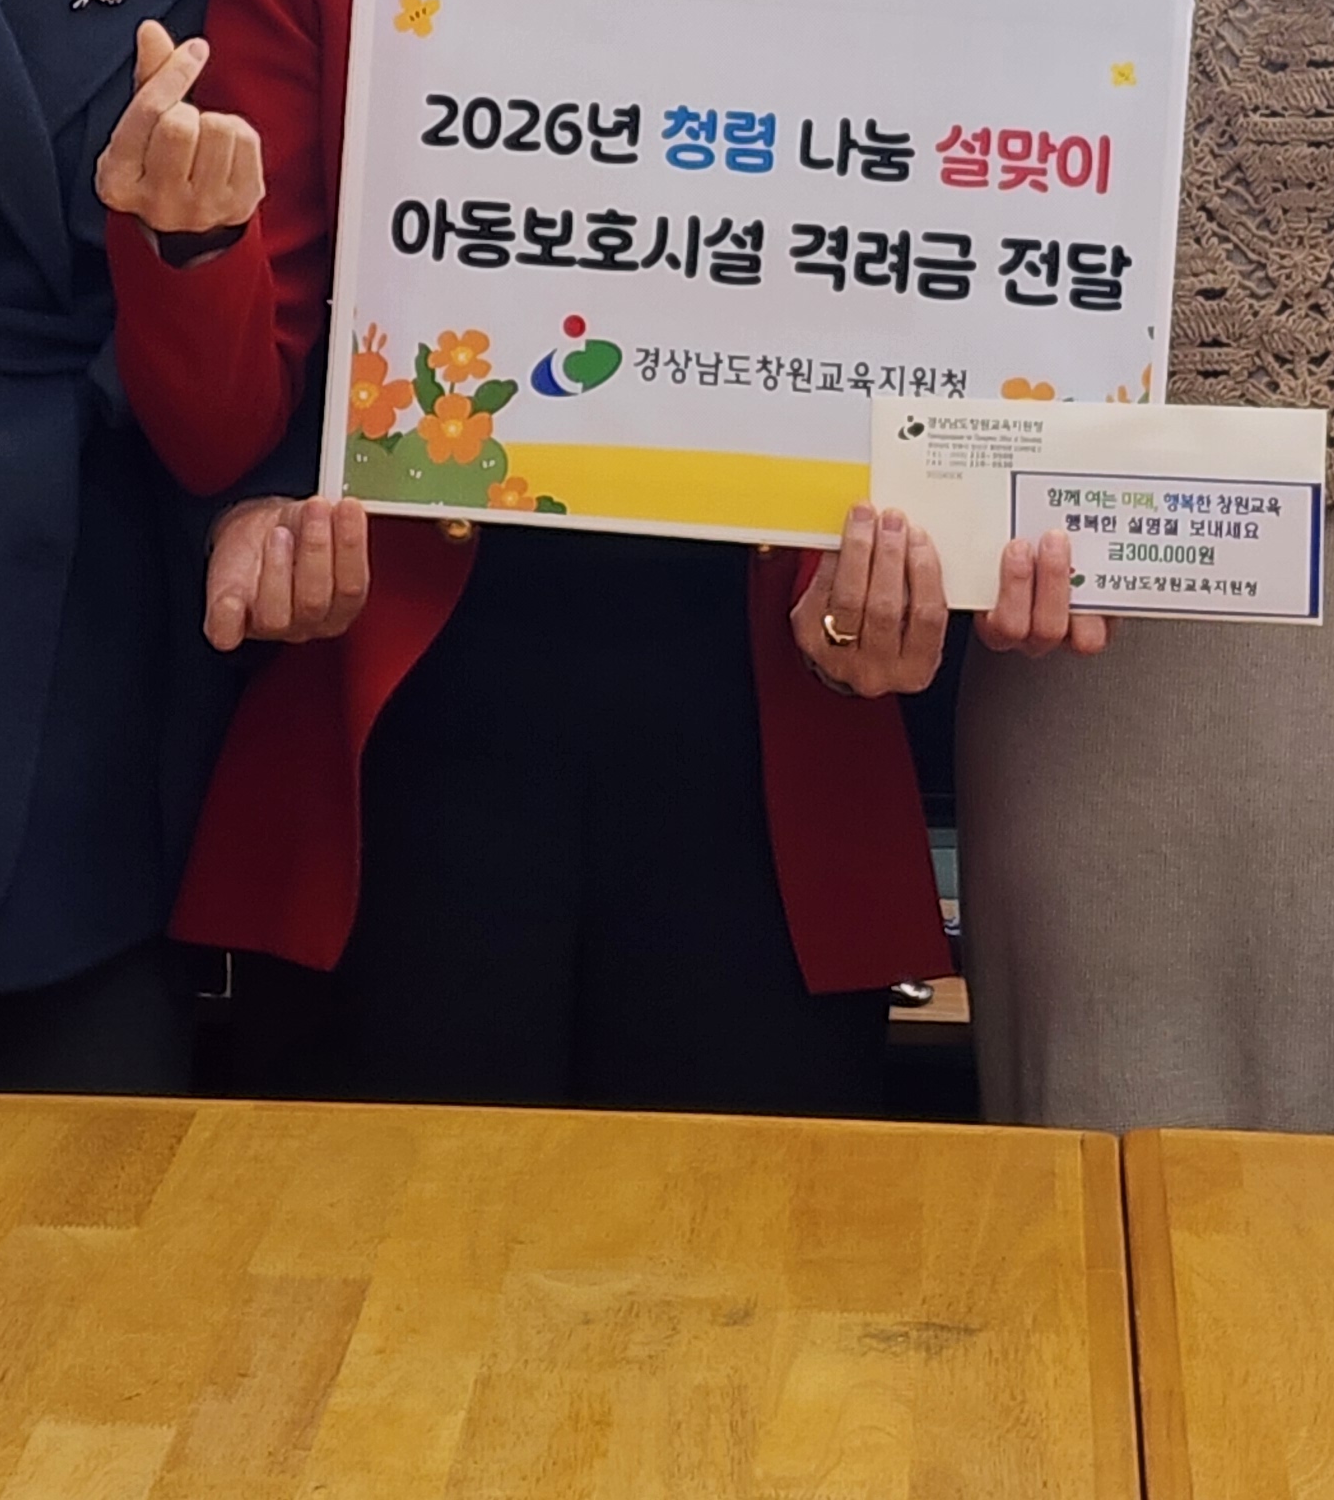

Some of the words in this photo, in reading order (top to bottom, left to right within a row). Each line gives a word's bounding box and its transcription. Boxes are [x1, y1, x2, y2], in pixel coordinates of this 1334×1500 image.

[421, 93, 641, 164] 2026년
[661, 104, 776, 173] 청렴
[799, 117, 915, 182] 나눔
[935, 124, 1111, 195] 설맞이
[391, 198, 764, 285] 아동보호시설
[789, 223, 977, 300] 격려금
[998, 237, 1132, 311] 전달
[632, 346, 967, 398] 경상남도창원교육지원청
[1047, 487, 1081, 507] 함께
[1084, 489, 1117, 510] 여는
[1121, 491, 1158, 512] 미래,
[1163, 492, 1211, 514] 행복한
[1216, 494, 1282, 517] 창원교육
[1065, 513, 1117, 533] 행복한
[1128, 516, 1179, 536] 설명절
[1189, 518, 1259, 539] 보내세요
[1094, 573, 1258, 597] 경상남도창원교육지원청
